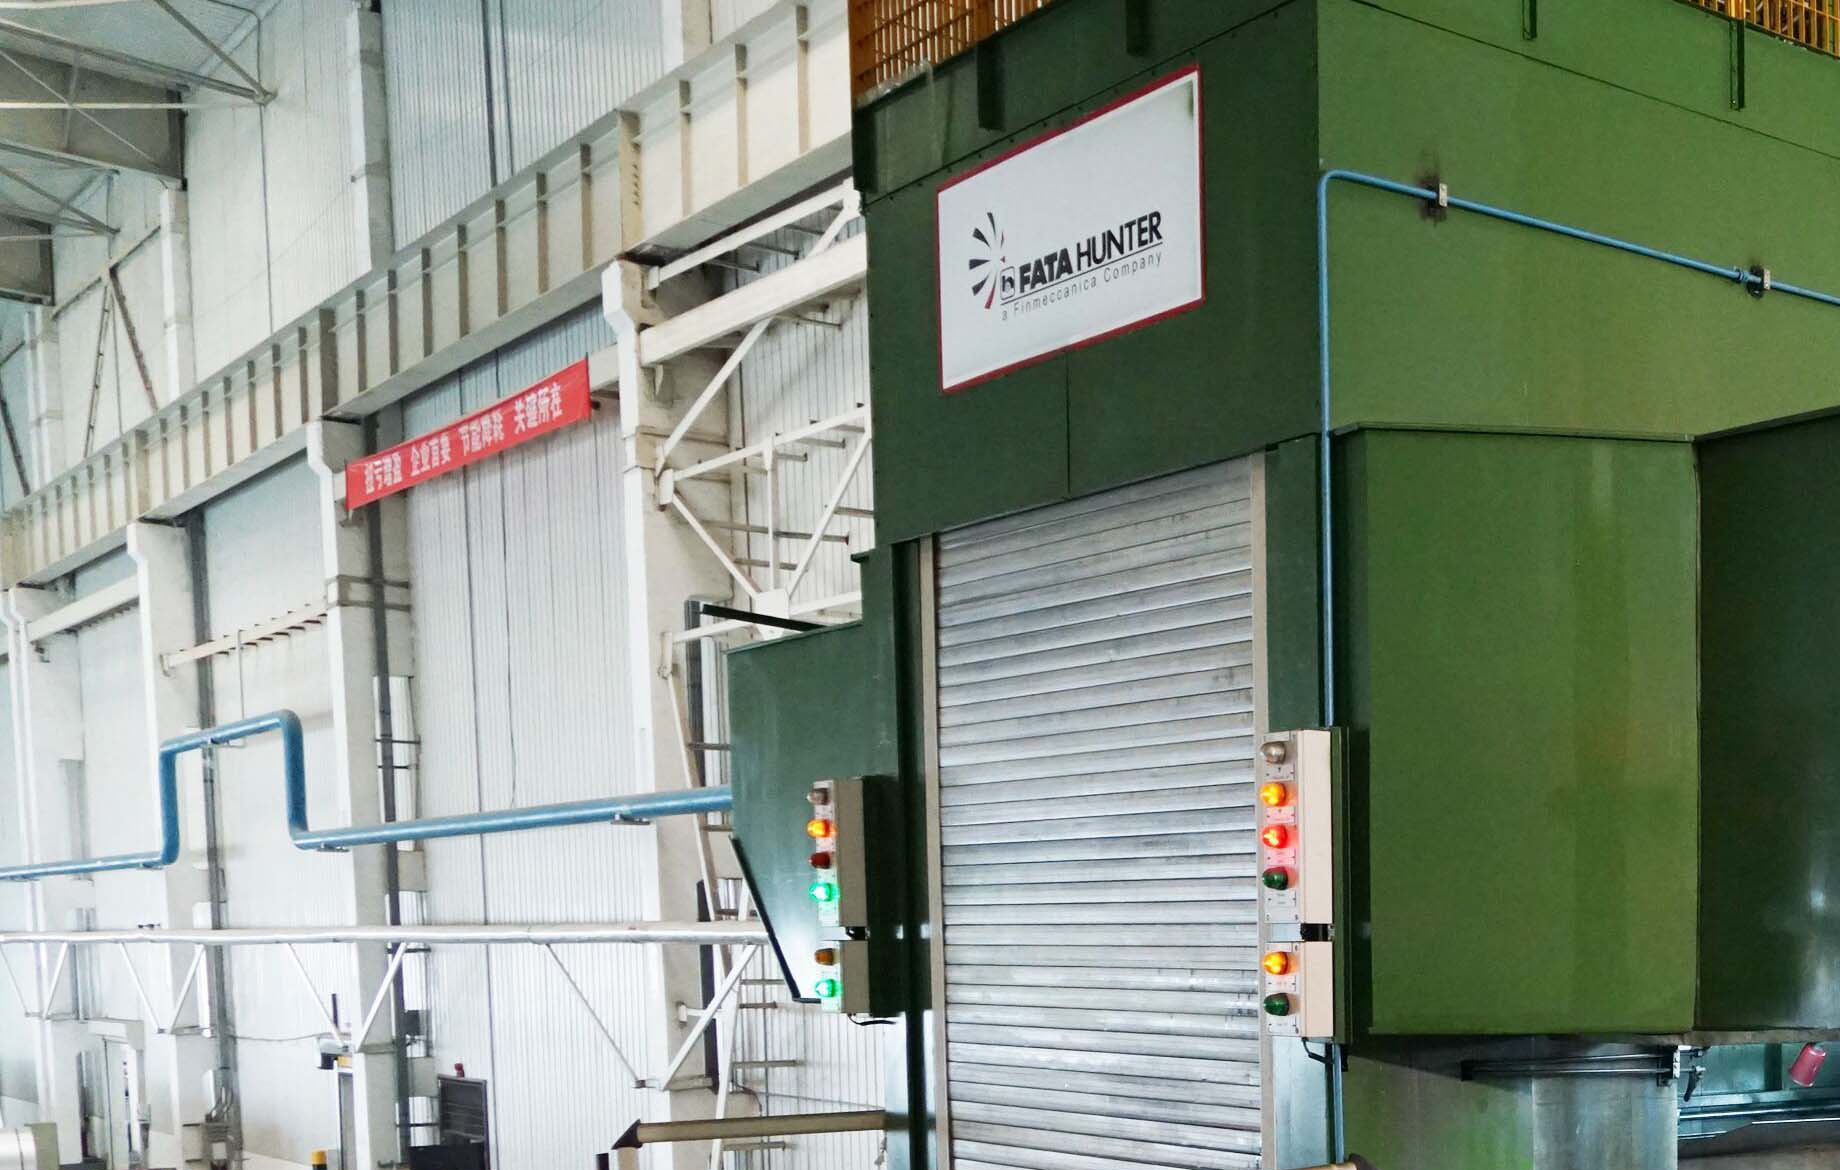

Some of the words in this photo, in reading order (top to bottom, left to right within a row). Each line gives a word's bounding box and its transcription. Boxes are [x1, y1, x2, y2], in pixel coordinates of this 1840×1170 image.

[1001, 309, 1008, 321] a
[1013, 275, 1097, 317] Finmeccanica
[1103, 251, 1162, 283] Company
[1019, 248, 1073, 293] FATA
[1076, 211, 1162, 271] HUNTER
